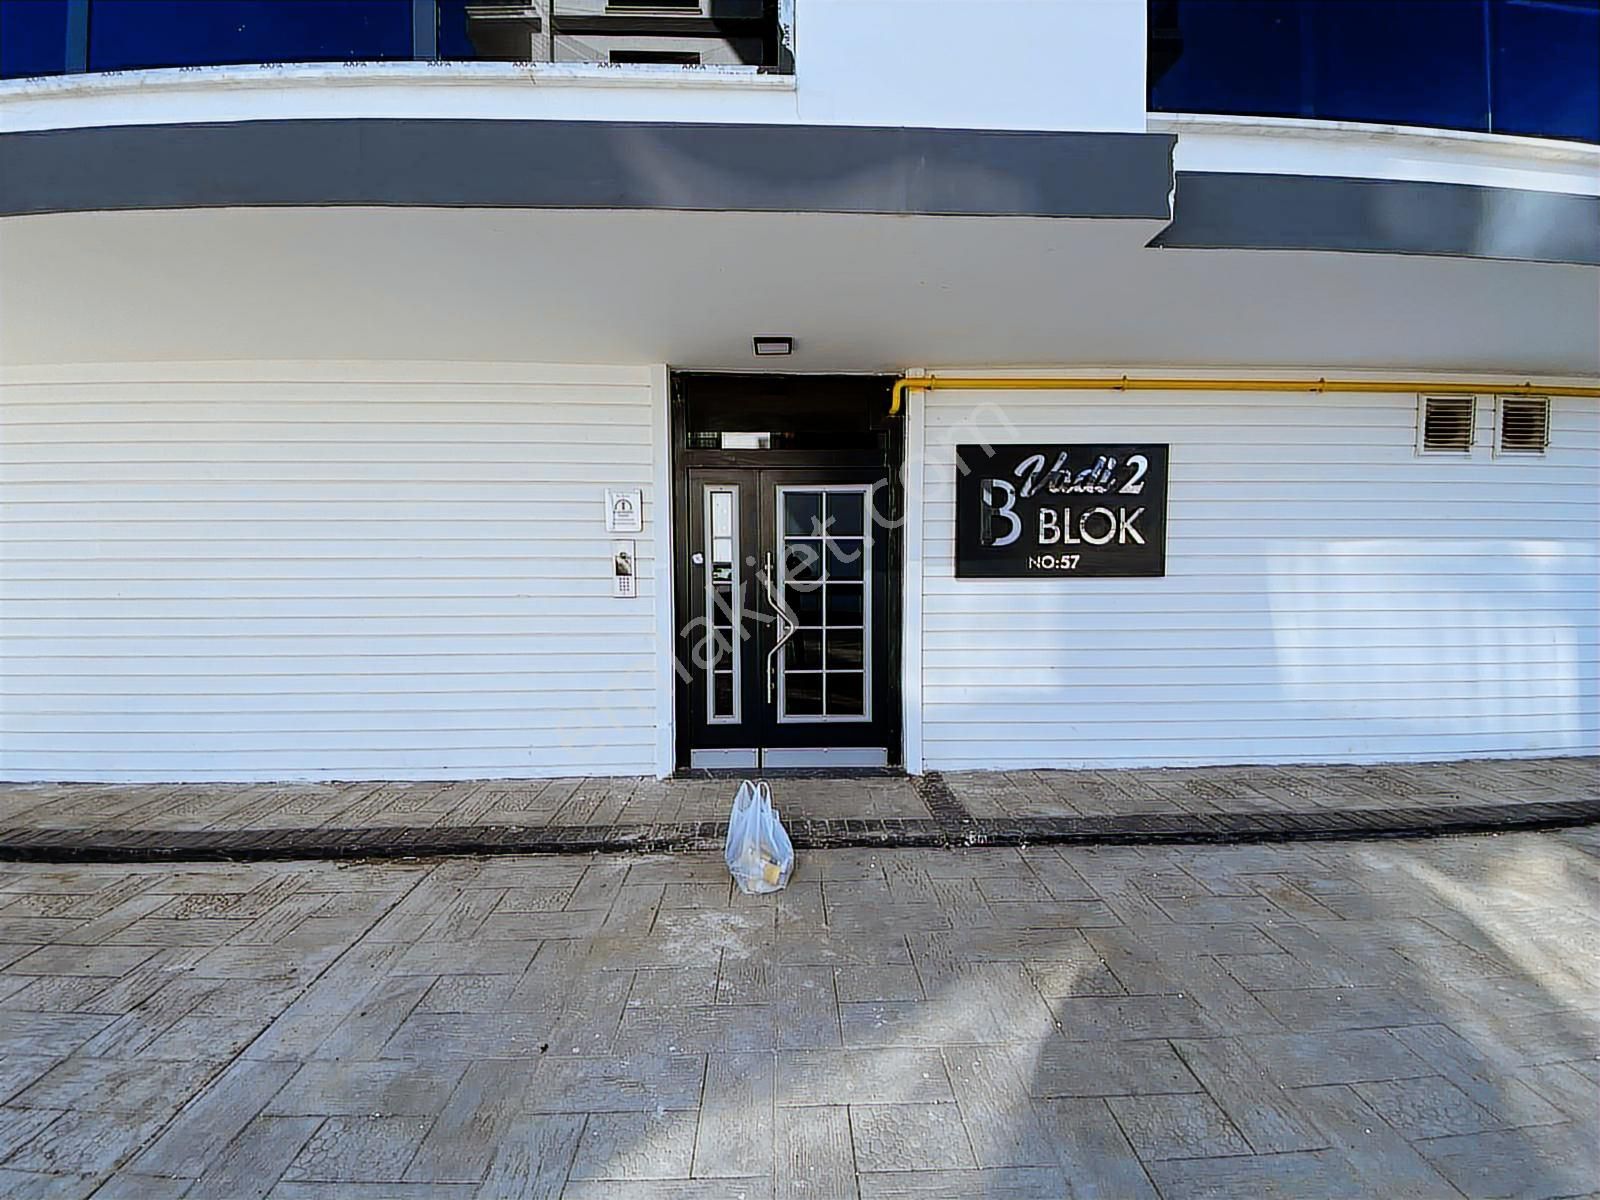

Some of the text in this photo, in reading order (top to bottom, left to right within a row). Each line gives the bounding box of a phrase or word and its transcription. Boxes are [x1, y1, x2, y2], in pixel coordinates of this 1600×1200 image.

[1119, 454, 1148, 494] 2
[980, 479, 1146, 546] B BLOK
[1028, 554, 1081, 570] NO:57
